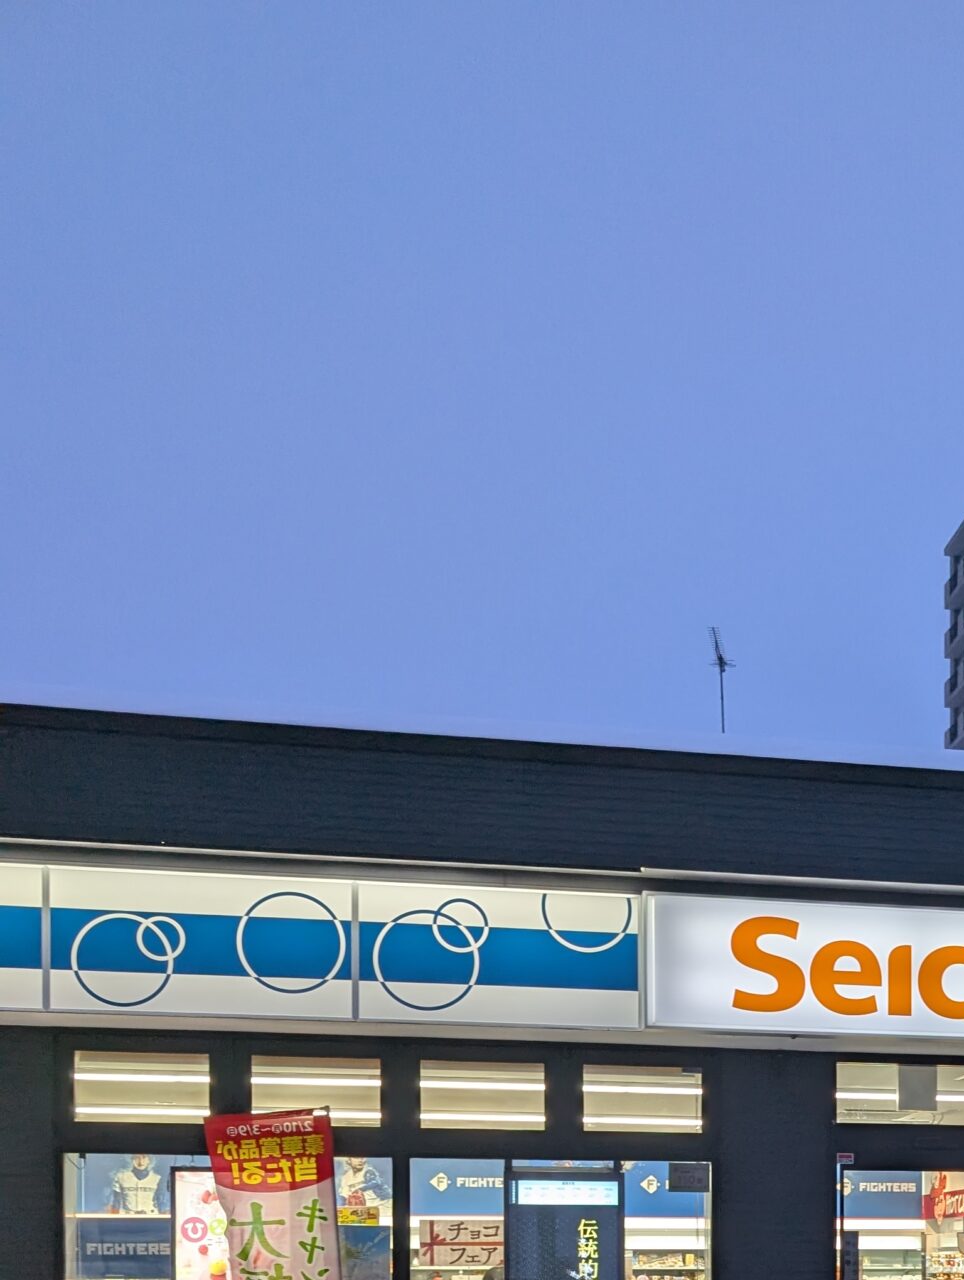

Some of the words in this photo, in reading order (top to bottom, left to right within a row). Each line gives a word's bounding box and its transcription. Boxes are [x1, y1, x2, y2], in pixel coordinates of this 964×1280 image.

[858, 1182, 917, 1193] FIGHTERS
[447, 1221, 500, 1241] チョコ
[86, 1242, 171, 1256] FIGHTERS
[449, 1246, 499, 1265] フェア
